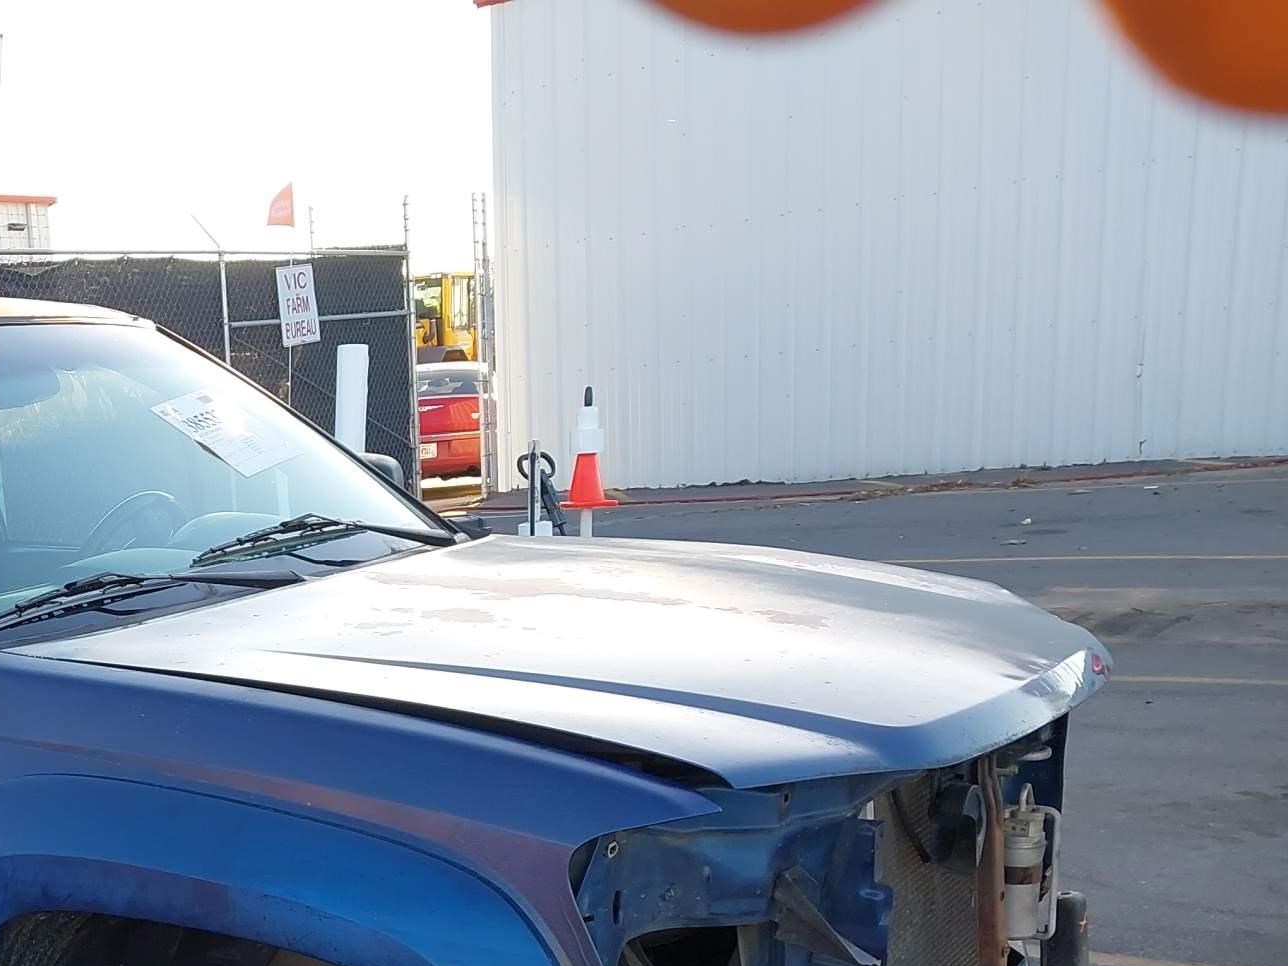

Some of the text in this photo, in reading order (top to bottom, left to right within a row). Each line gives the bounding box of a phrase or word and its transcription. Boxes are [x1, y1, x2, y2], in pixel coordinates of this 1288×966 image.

[284, 271, 307, 290] VIC
[286, 295, 311, 315] FARM
[285, 318, 317, 340] BUREAU
